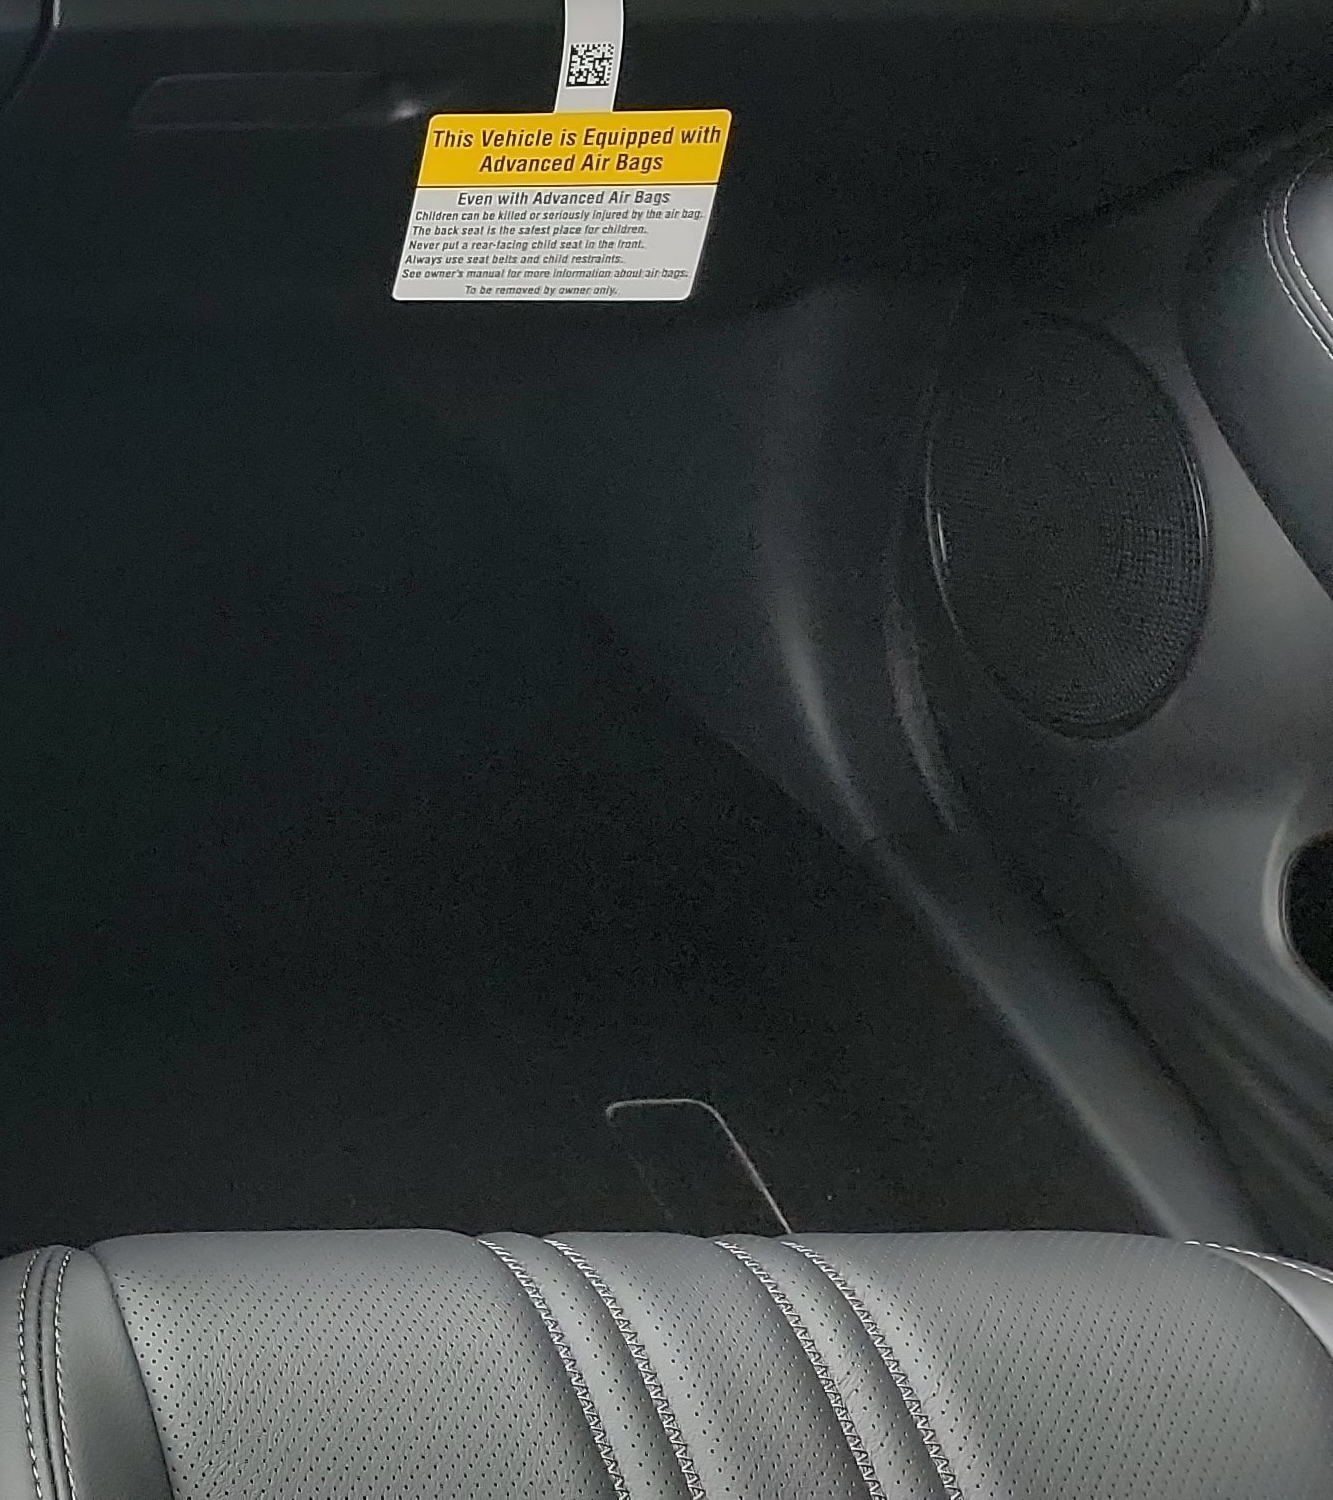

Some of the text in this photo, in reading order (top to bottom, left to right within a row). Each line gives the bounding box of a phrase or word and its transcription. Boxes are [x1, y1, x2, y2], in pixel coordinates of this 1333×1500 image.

[432, 125, 722, 150] This Vehicle is Equipped with
[479, 152, 664, 174] Advanced Air Bags
[457, 190, 671, 206] Even with Advanced Air Bags
[415, 208, 704, 222] Children can be killed or seriously injured by the air bag.
[412, 224, 648, 236] The back seat is the safest place for children.
[408, 239, 645, 251] Never put a rear-facing child seat in the front.
[404, 254, 624, 266] Always use seat belts and child restraints.
[401, 268, 689, 279] See owner's manual for more information about air bags.
[465, 285, 618, 296] To be removed by owner only.
